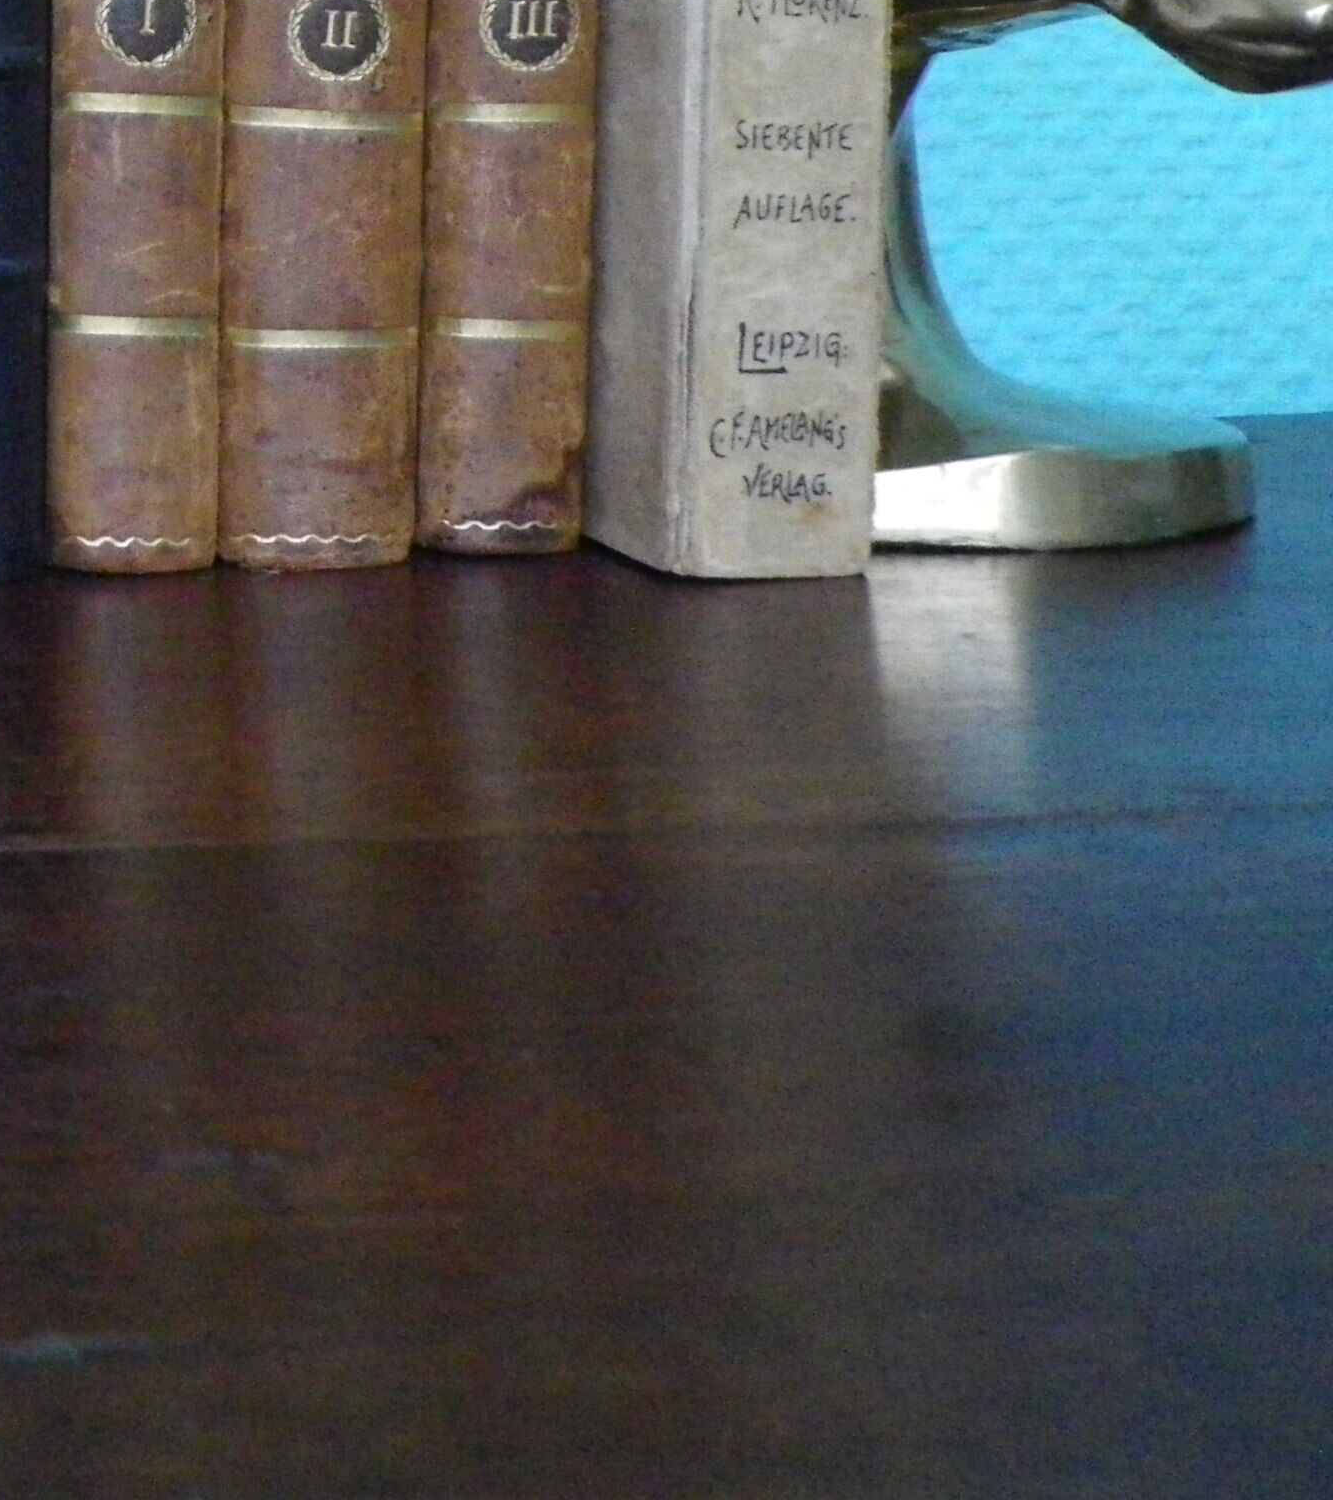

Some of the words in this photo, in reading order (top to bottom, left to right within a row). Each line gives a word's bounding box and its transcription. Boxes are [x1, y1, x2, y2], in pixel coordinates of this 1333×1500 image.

[319, 9, 358, 49] II
[505, 0, 559, 40] III
[736, 119, 853, 160] SIEBENTE
[733, 193, 856, 230] AUFLAGE.
[742, 462, 833, 504] VERLAG.
